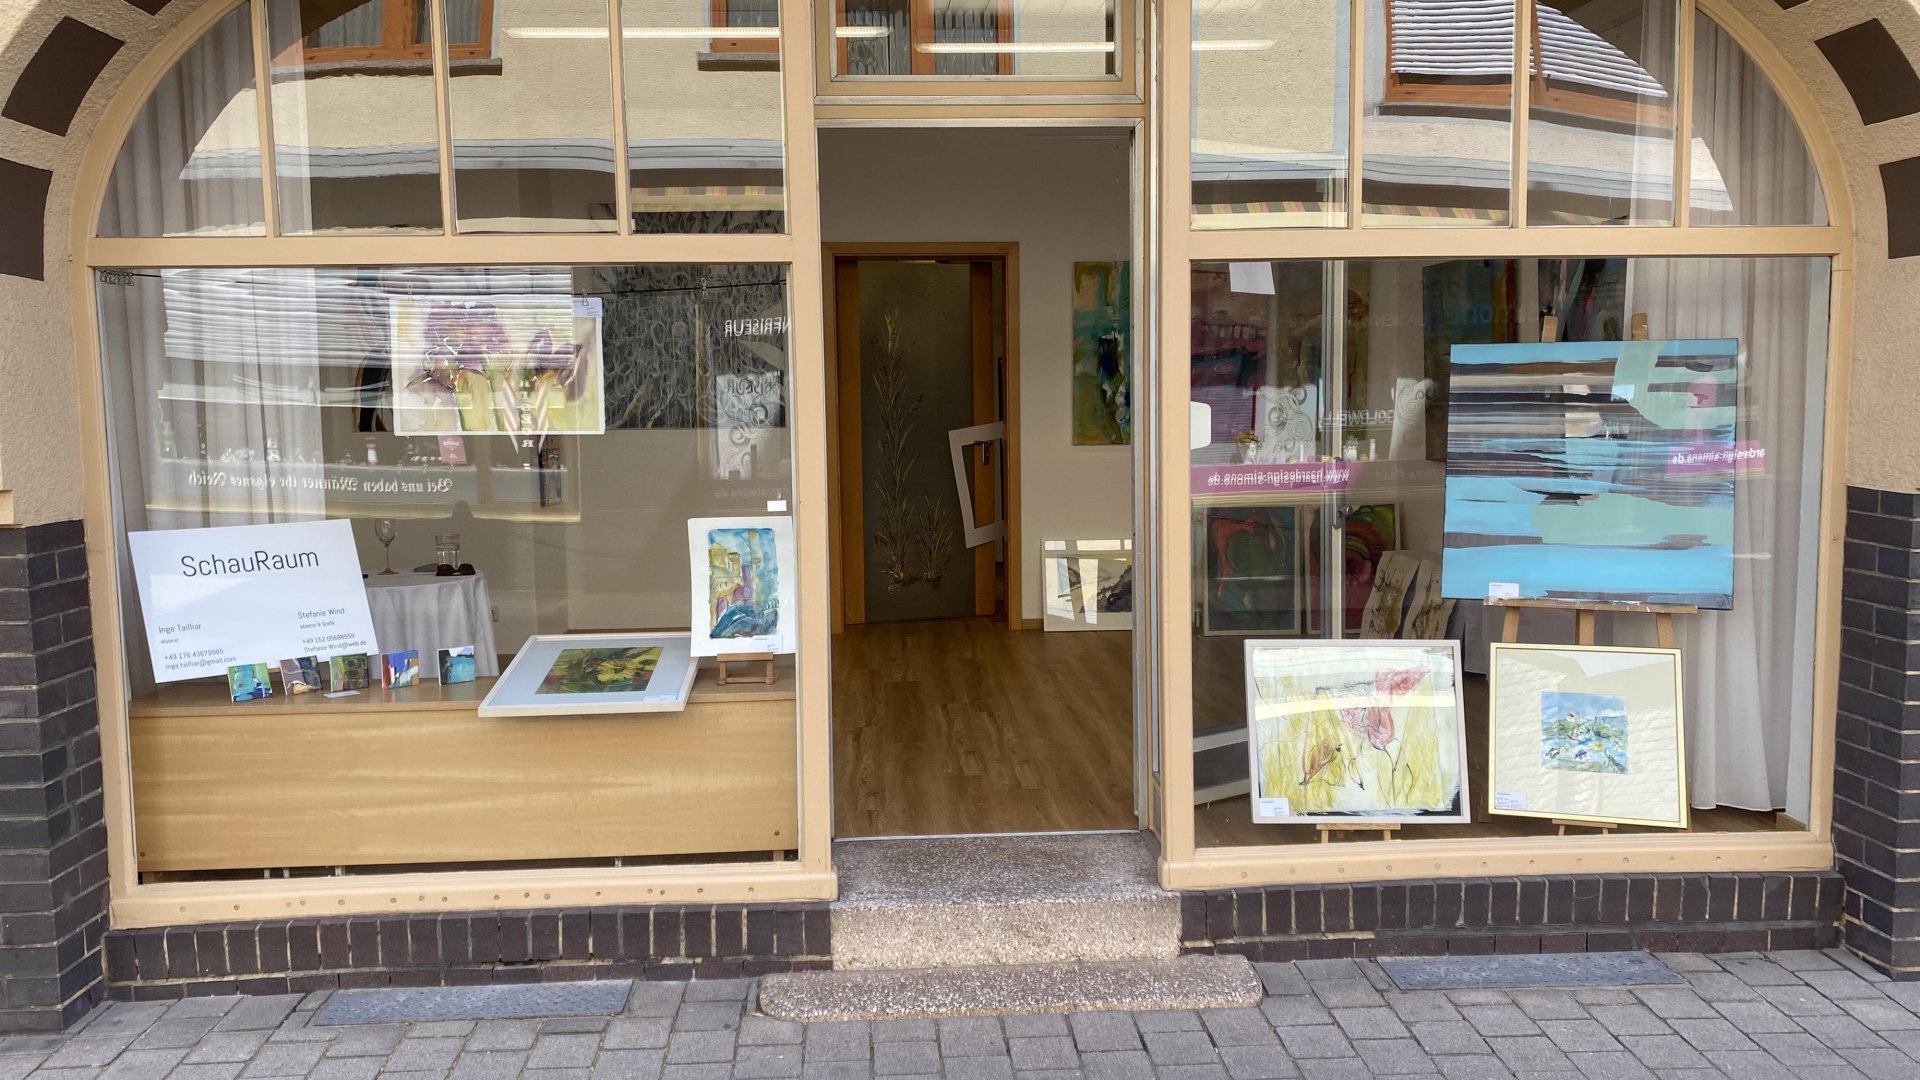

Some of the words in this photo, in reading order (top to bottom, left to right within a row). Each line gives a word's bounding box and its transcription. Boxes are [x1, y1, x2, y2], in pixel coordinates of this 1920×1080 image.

[181, 550, 319, 577] SchauRaum
[297, 610, 327, 619] Stefanie
[328, 607, 345, 616] Wind
[158, 625, 175, 635] Inge
[177, 623, 201, 632] Tailliar
[302, 636, 314, 645] +49
[164, 653, 178, 661] +49
